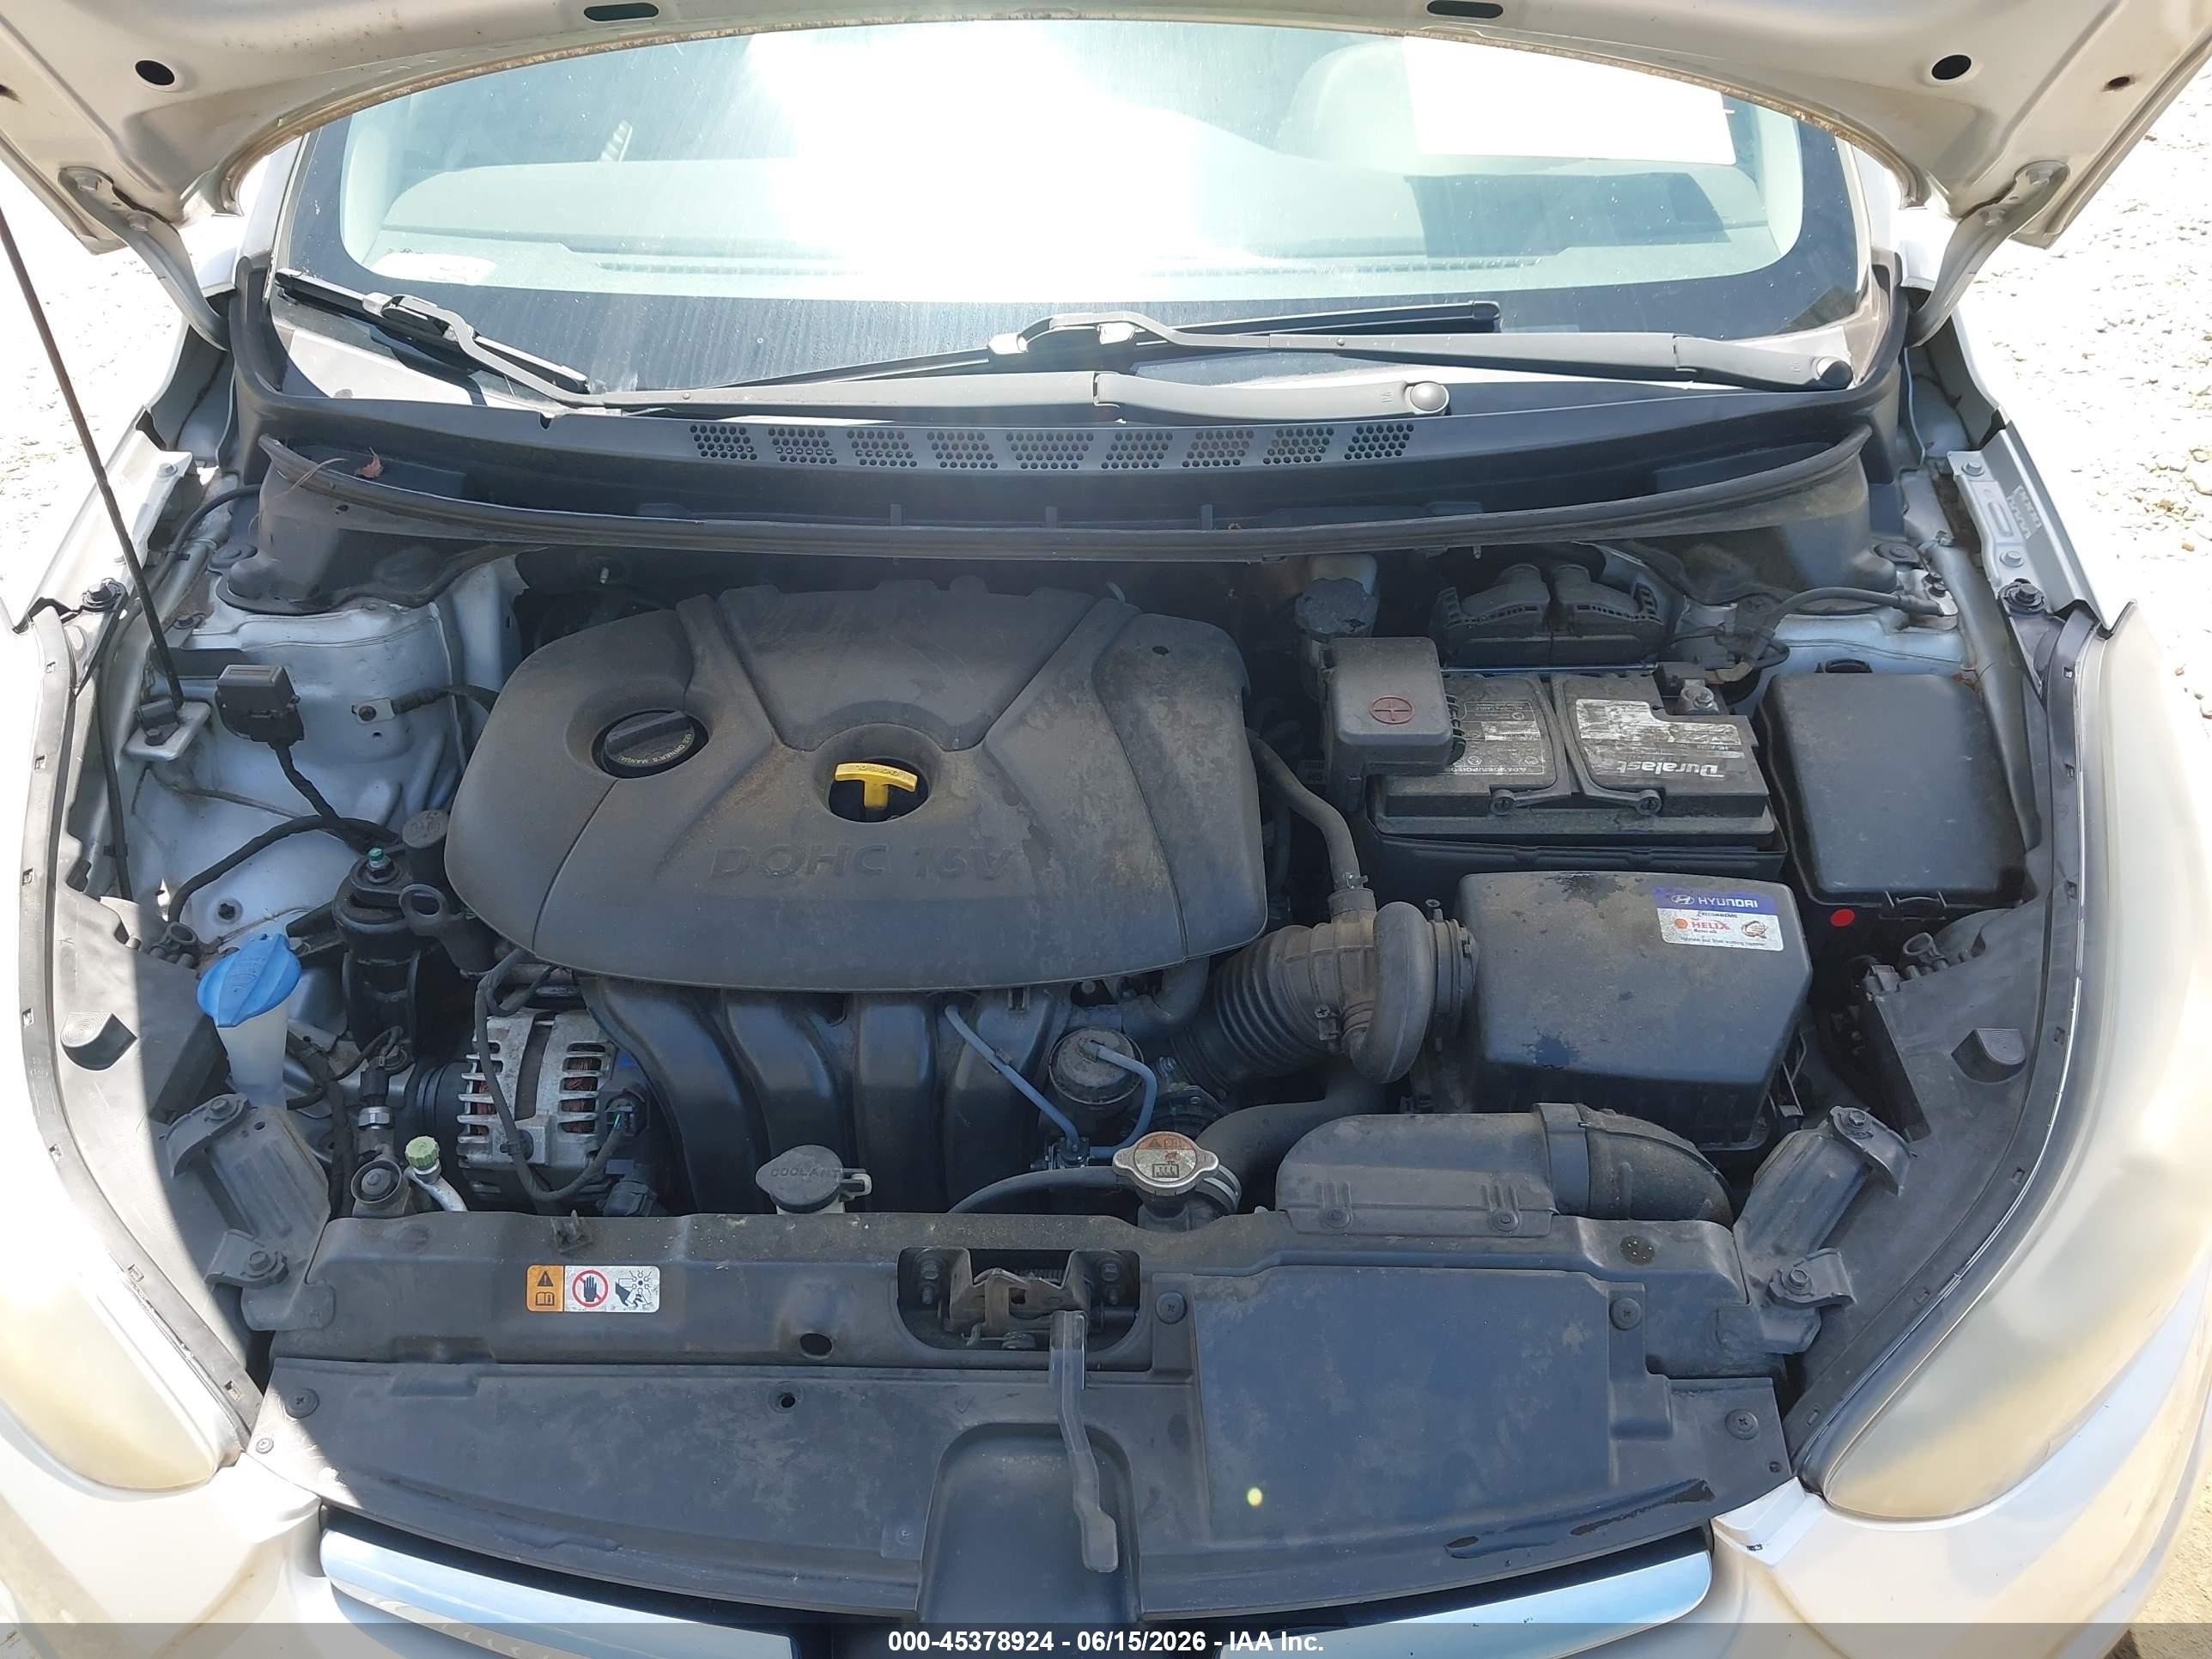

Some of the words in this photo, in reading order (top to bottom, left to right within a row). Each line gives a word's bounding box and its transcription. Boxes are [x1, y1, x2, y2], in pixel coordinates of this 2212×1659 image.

[1616, 761, 1725, 778] Duralast
[709, 844, 891, 879] DOHC
[913, 844, 1017, 882] 16V
[1698, 896, 1759, 908] HYUNDAI
[1692, 920, 1731, 931] HELIX
[770, 1168, 841, 1179] COOLANT
